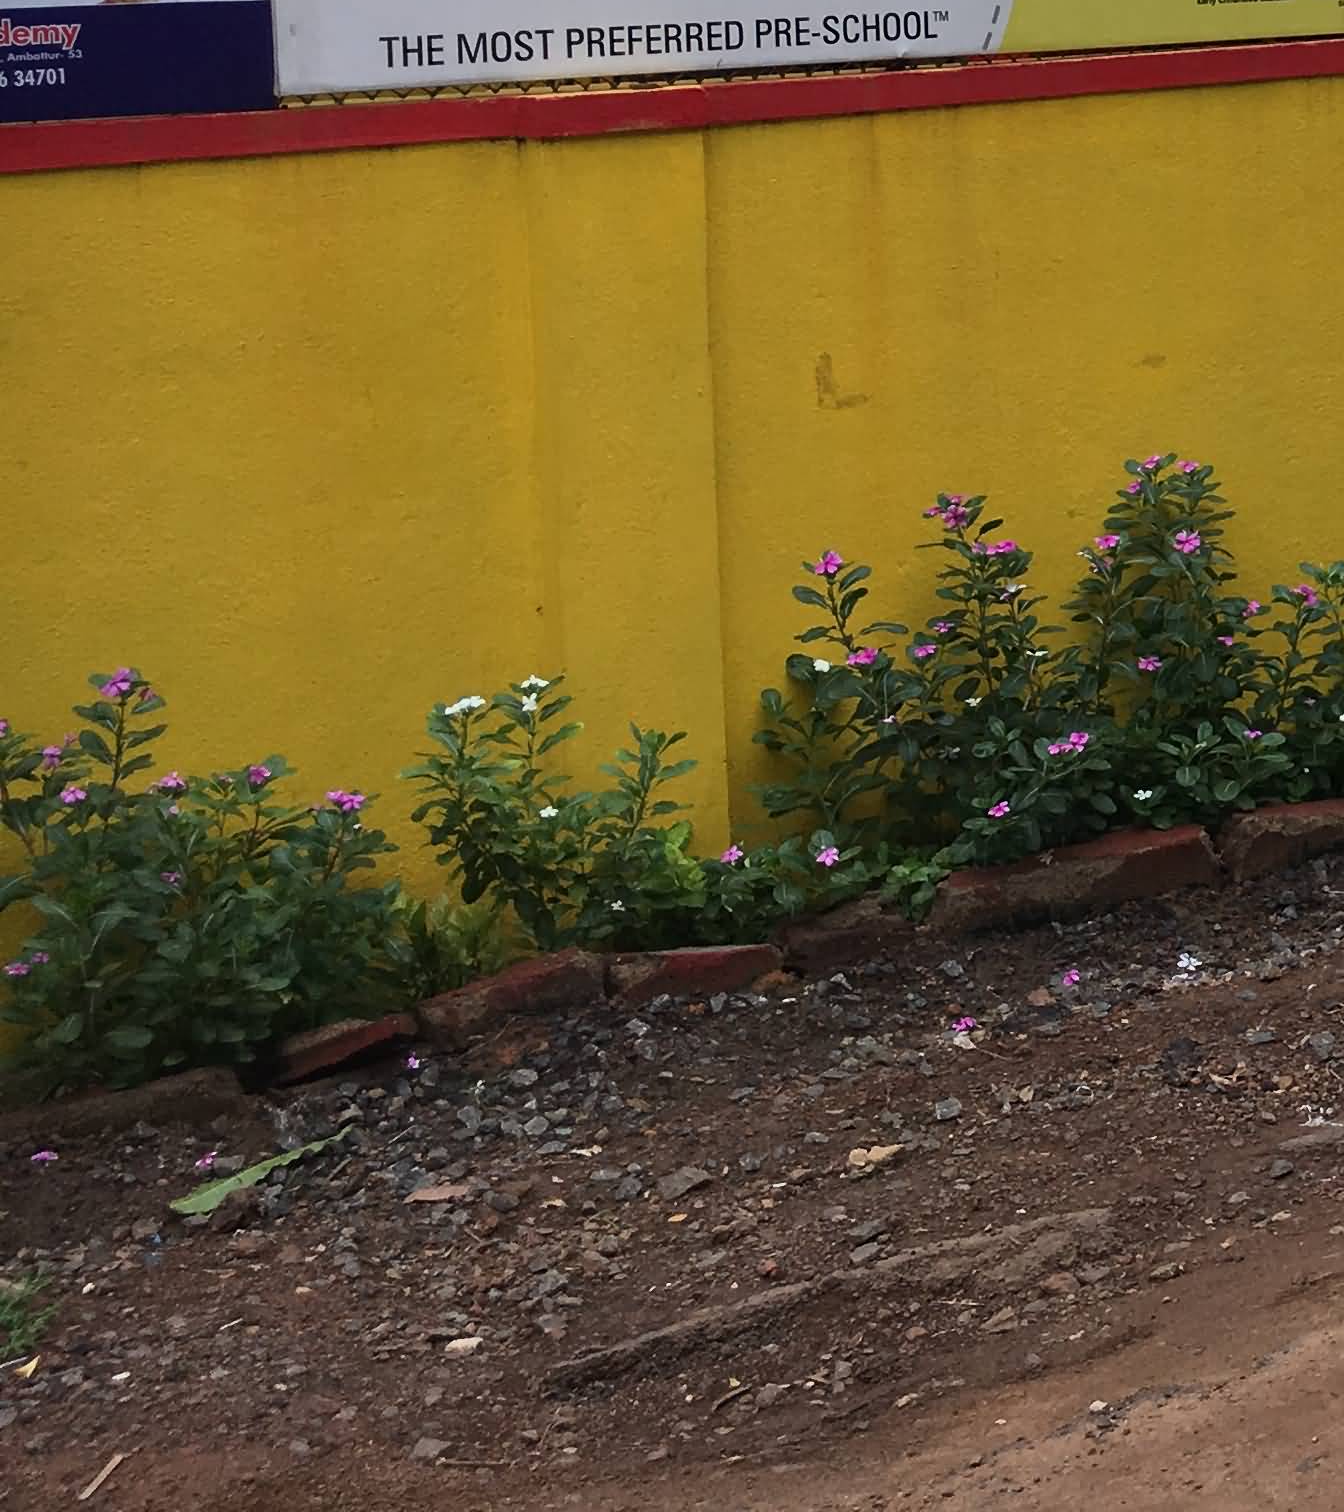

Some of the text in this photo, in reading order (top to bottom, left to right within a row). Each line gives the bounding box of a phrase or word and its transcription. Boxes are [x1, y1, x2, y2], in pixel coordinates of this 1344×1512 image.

[68, 49, 83, 59] 53
[379, 34, 445, 69] THE
[456, 29, 554, 65] MOST
[565, 20, 744, 60] PREFERRED
[14, 68, 66, 87] 34701
